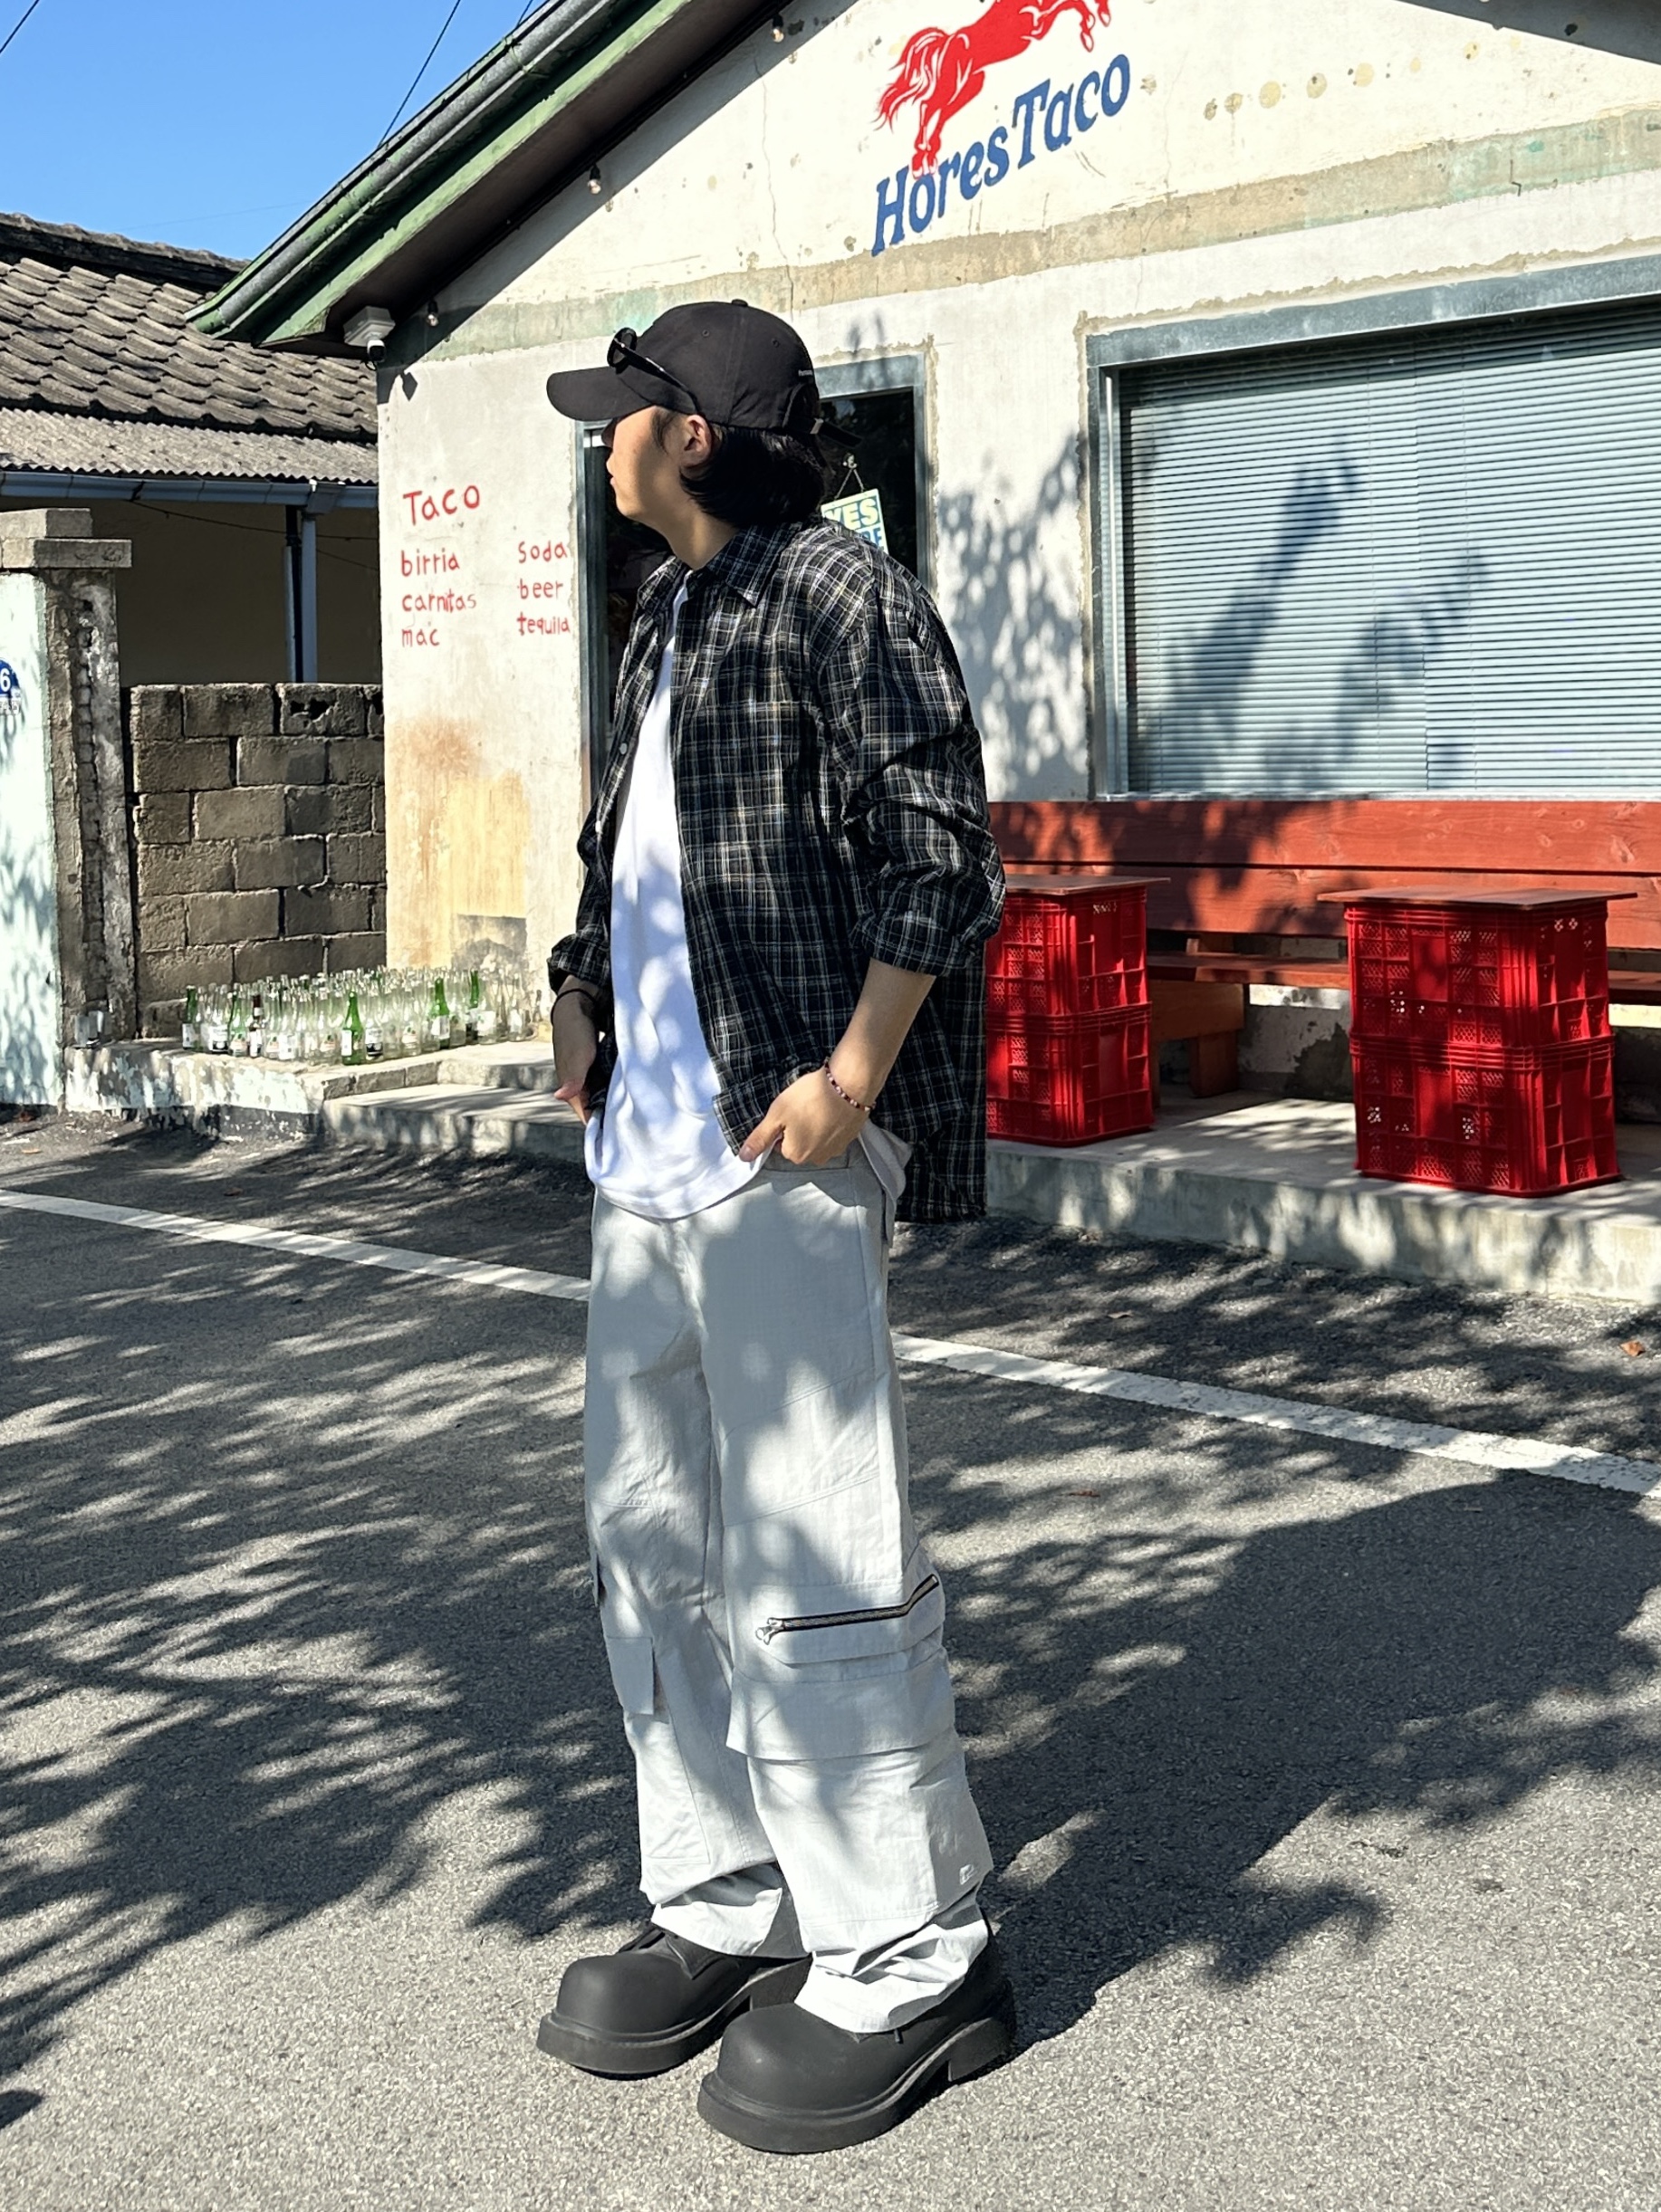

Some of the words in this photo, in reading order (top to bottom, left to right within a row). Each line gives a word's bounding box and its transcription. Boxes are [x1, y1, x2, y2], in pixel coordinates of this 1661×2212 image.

[402, 484, 481, 526] Taco
[400, 547, 460, 578] birria
[401, 589, 477, 614] carnitas
[517, 578, 564, 599] beer
[516, 611, 571, 637] tequila
